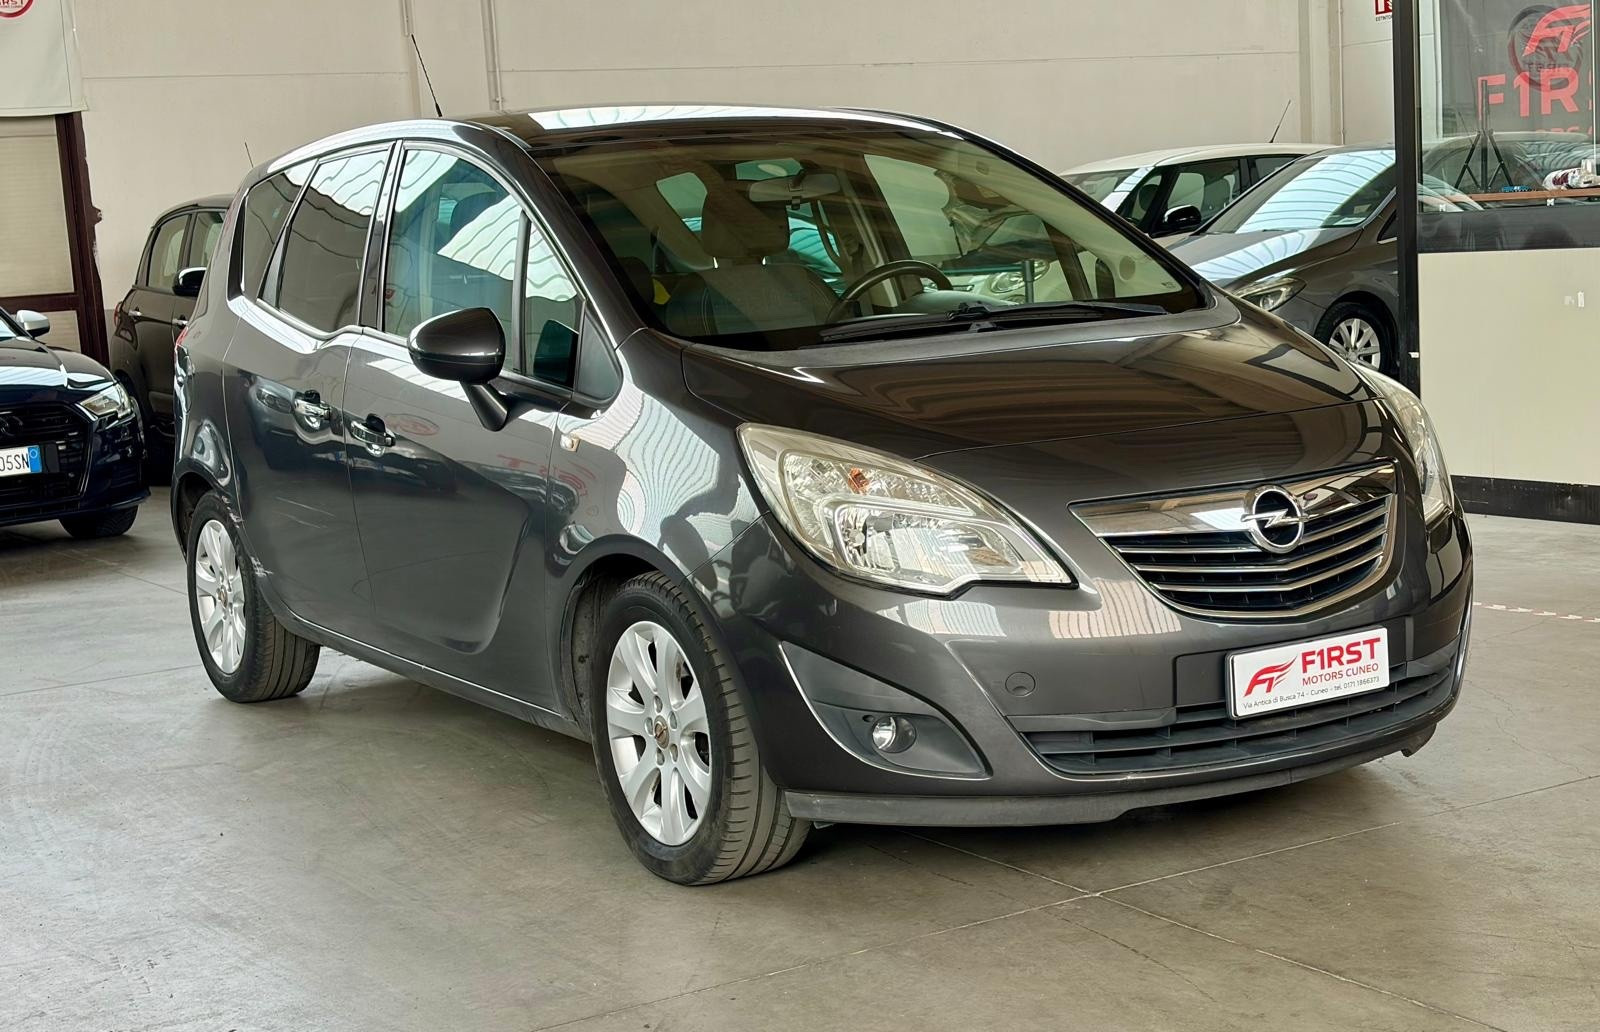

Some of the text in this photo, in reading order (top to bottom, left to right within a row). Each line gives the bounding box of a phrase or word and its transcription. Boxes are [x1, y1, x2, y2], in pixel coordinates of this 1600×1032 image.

[1478, 66, 1592, 121] F1R
[1302, 663, 1379, 686] MOTORS CUNEO
[1253, 699, 1272, 707] Antica
[1279, 694, 1297, 702] Busca
[1296, 691, 1305, 699] 74
[1310, 688, 1329, 696] Cuneo
[1343, 681, 1356, 689] 0171
